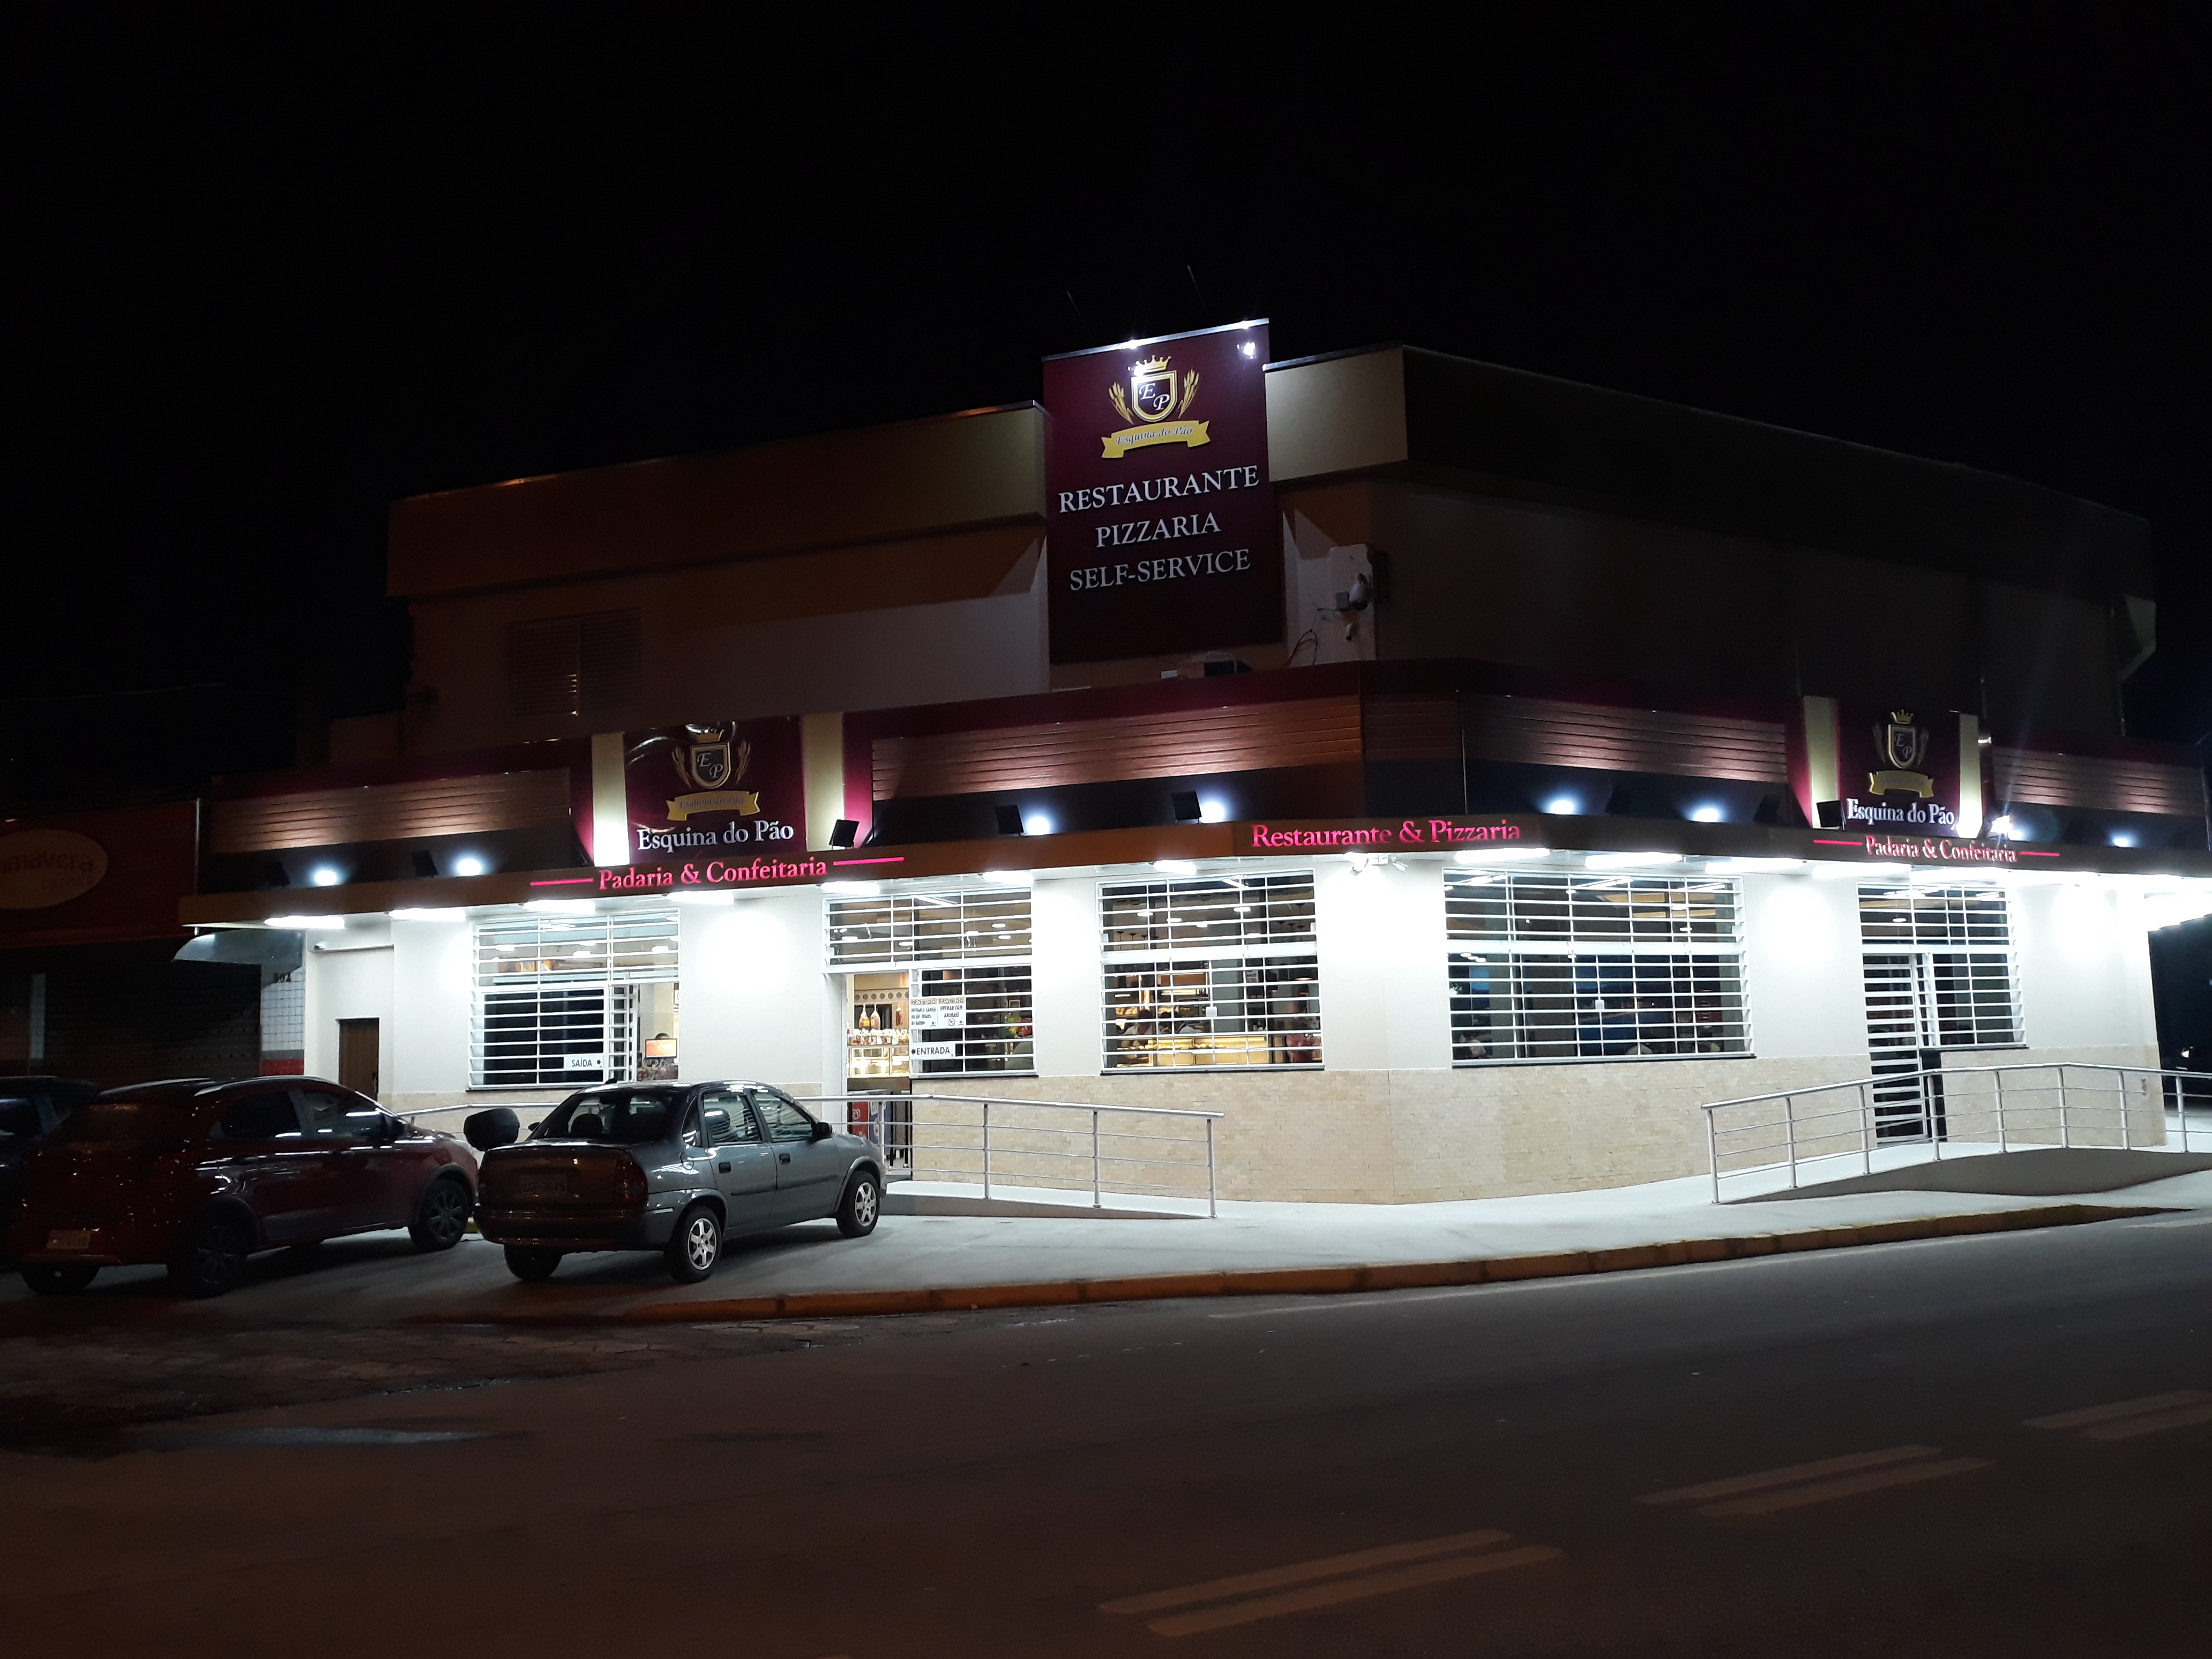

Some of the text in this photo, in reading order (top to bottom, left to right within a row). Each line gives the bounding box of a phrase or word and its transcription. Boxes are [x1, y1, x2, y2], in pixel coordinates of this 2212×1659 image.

[1116, 426, 1193, 445] Esquina do Pão
[1058, 465, 1259, 513] RESTAURANTE
[1096, 512, 1221, 548] PIZZARIA
[1070, 549, 1251, 591] SELF-SERVICE
[1847, 798, 1955, 825] Esquina do Pão
[637, 820, 794, 853] Esquina do Pão
[1252, 819, 1520, 847] Restaurante & Pizzaria
[1865, 835, 2017, 862] Padaria & Confeitaria
[599, 856, 827, 890] Padaria & Confeitaria
[571, 1057, 593, 1067] SAÍDA
[917, 1047, 950, 1055] ENTRADA
